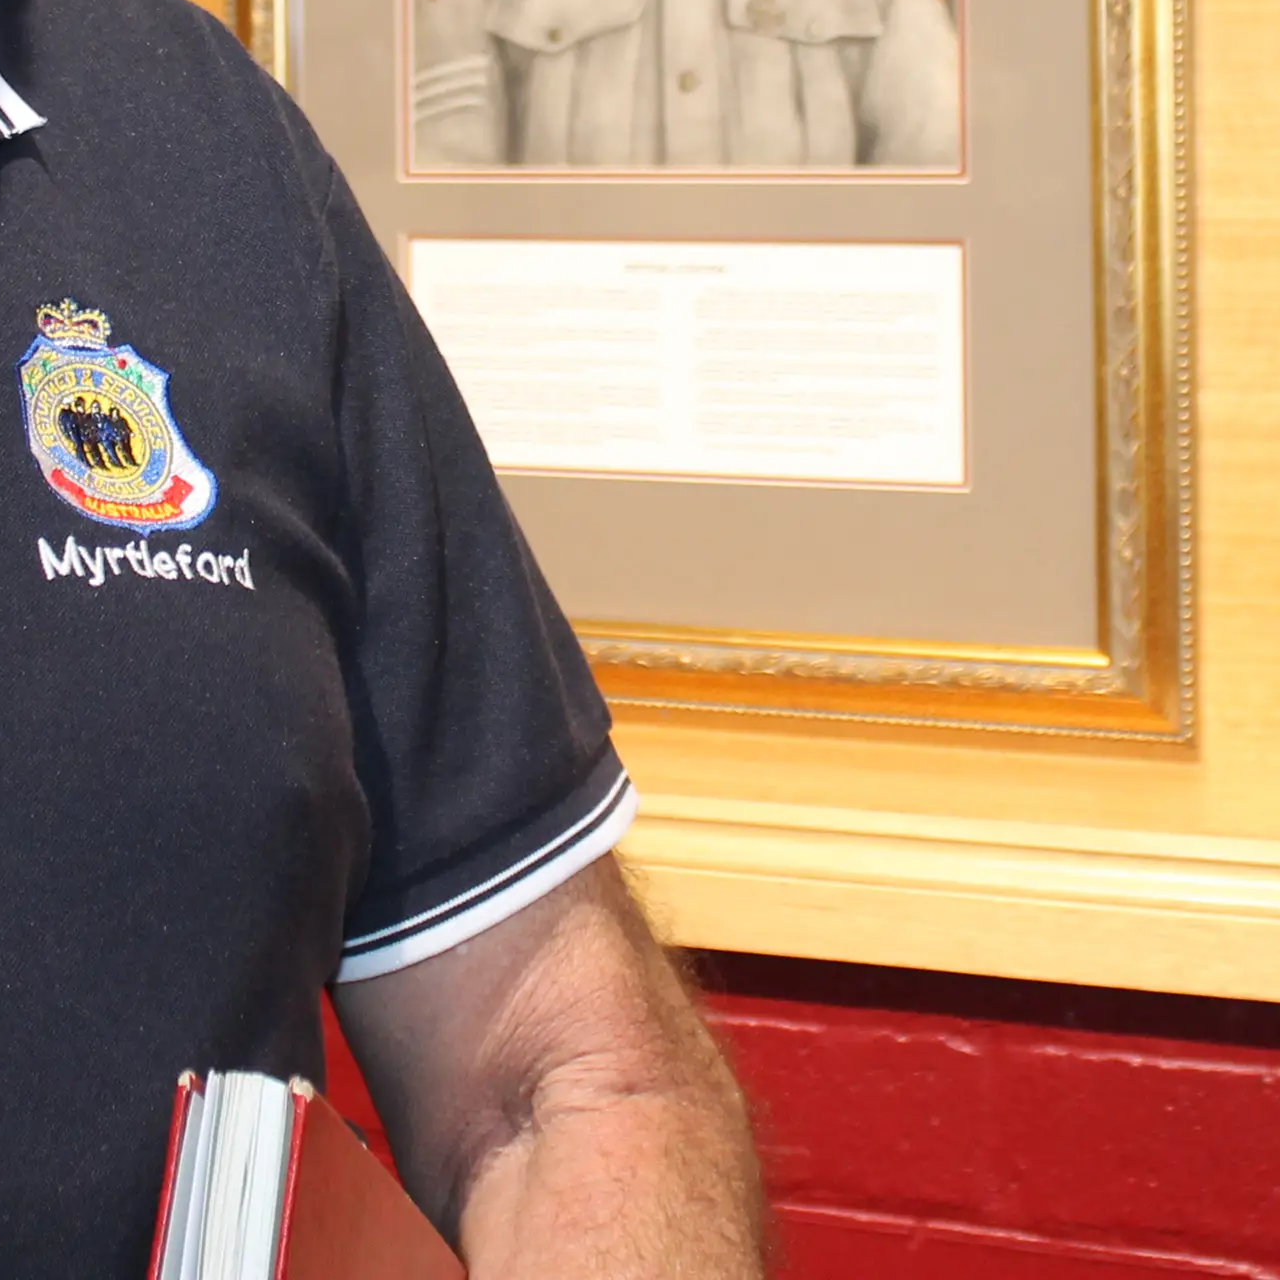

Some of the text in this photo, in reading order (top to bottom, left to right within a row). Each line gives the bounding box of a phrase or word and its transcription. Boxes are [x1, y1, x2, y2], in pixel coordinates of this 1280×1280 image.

[81, 369, 93, 387] &
[101, 375, 164, 449] SERVICES
[84, 496, 182, 519] AUSTRALIA
[37, 535, 256, 590] Myrtleford
